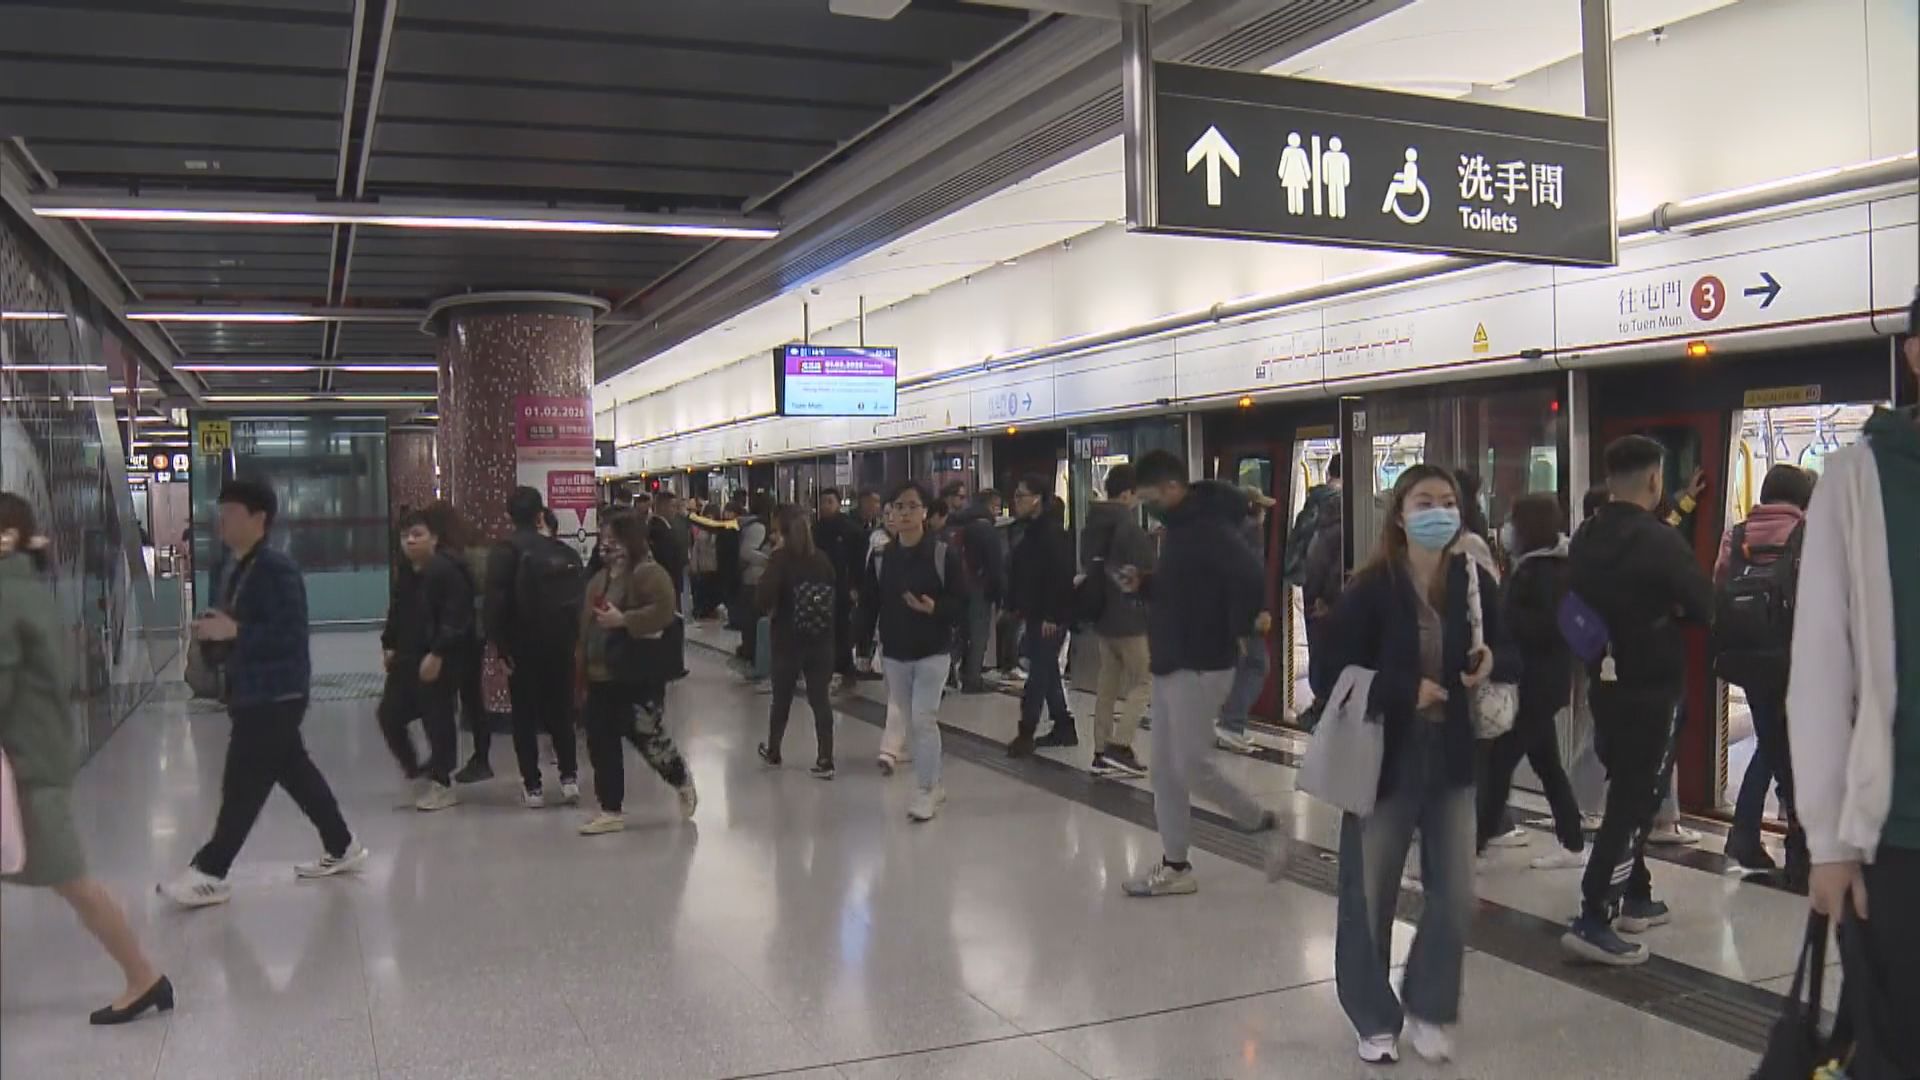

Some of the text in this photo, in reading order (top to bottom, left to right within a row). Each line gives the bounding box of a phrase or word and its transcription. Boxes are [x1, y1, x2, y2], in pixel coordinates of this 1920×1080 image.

[1458, 154, 1563, 209] 洗手間
[1458, 205, 1518, 233] Toilets
[1618, 280, 1681, 314] 往屯門
[1700, 283, 1716, 314] 3
[1619, 315, 1682, 334] to Tuen Mun
